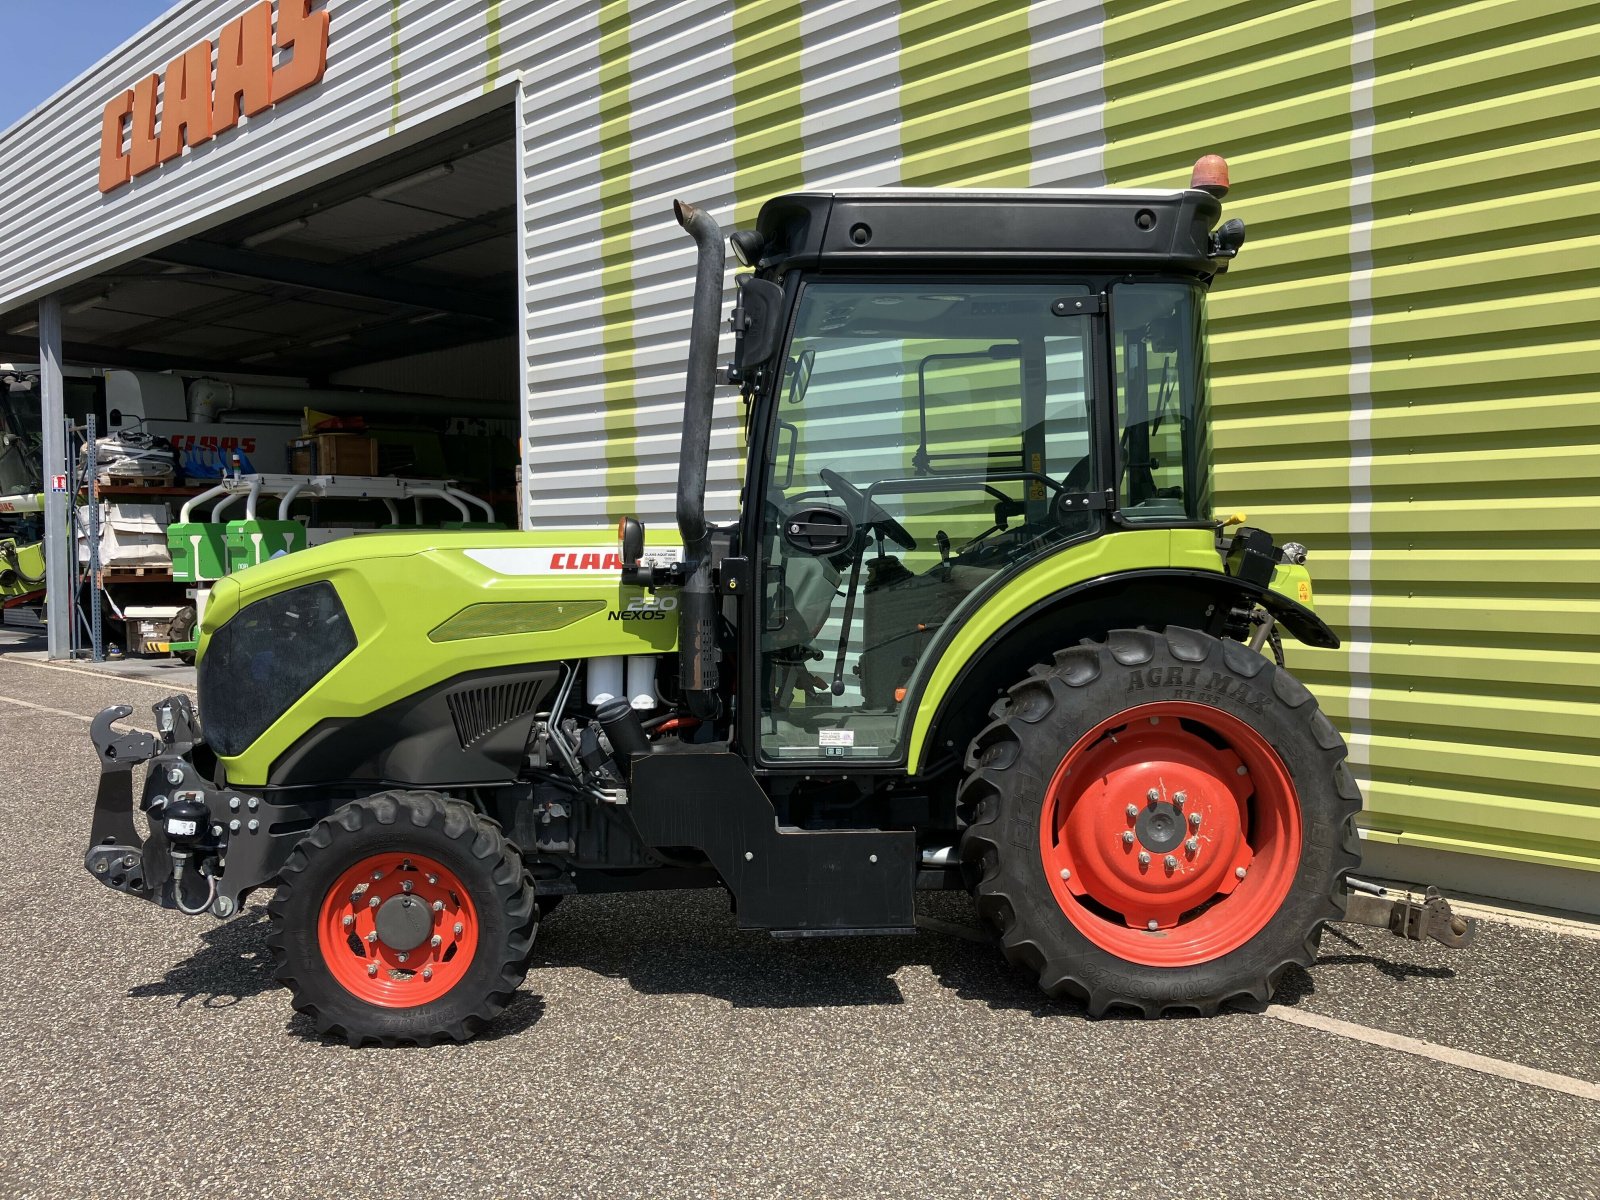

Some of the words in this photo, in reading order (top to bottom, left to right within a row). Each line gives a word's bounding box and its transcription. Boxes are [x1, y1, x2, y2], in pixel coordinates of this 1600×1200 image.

[98, 0, 330, 193] CLAAS
[549, 553, 642, 570] CLAA
[627, 596, 678, 611] 220
[607, 610, 667, 621] NEXOS
